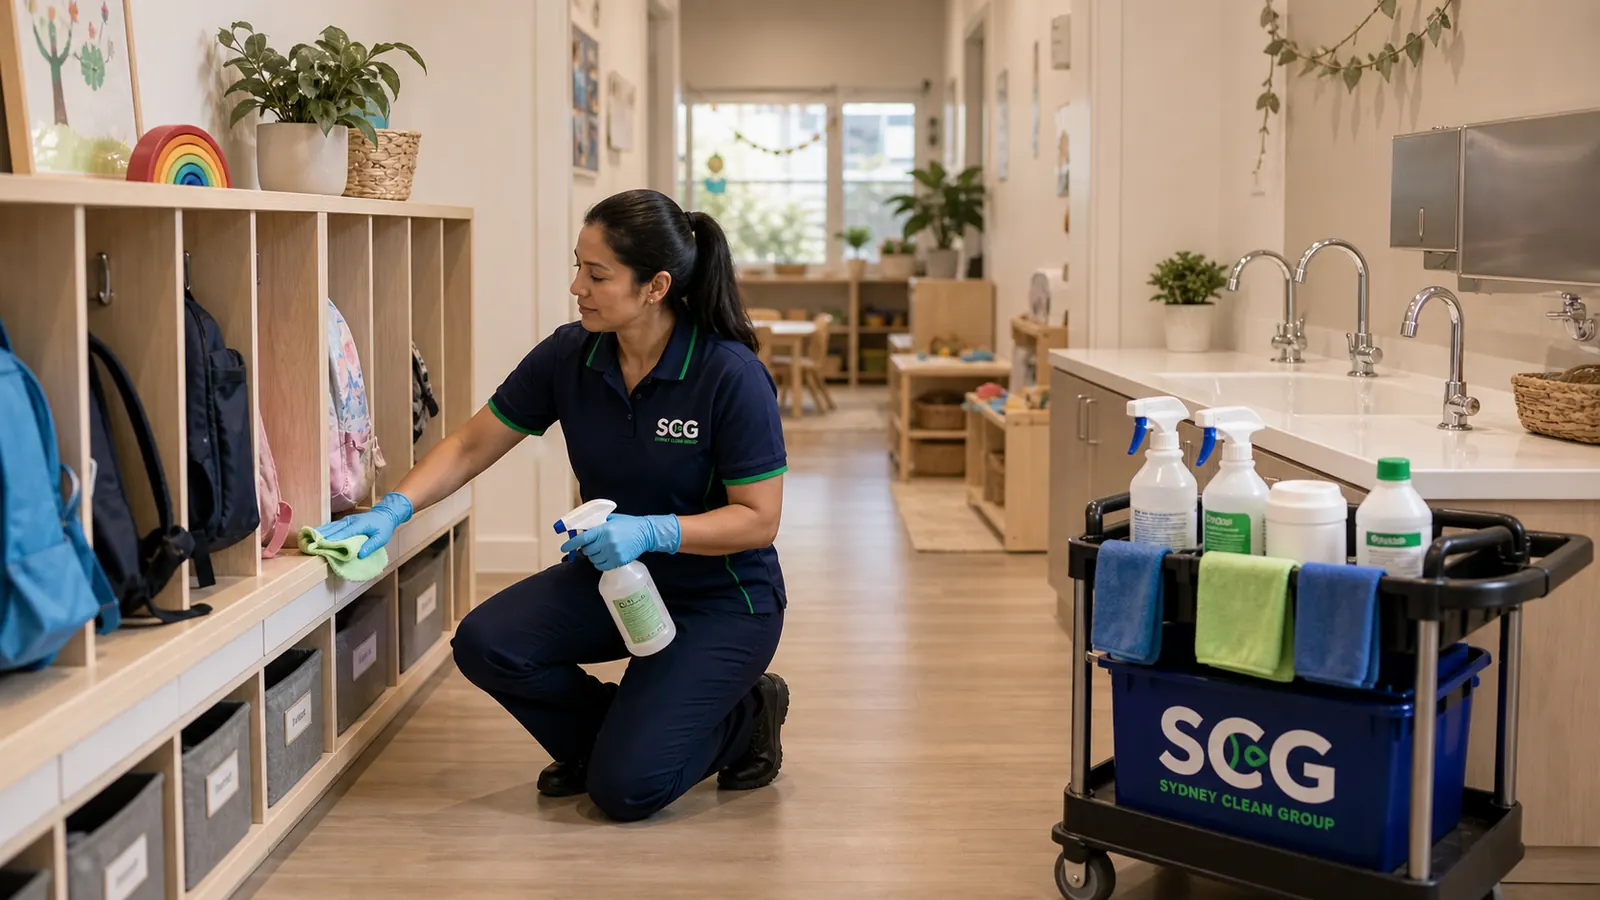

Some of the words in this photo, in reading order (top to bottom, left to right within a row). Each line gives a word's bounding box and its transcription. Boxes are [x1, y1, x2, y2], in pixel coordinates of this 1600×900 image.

[656, 418, 699, 438] SCG
[1159, 706, 1336, 804] SCG
[1159, 779, 1217, 804] SYDNEY
[1221, 794, 1272, 817] CLEAN
[1277, 807, 1335, 831] GROUP
